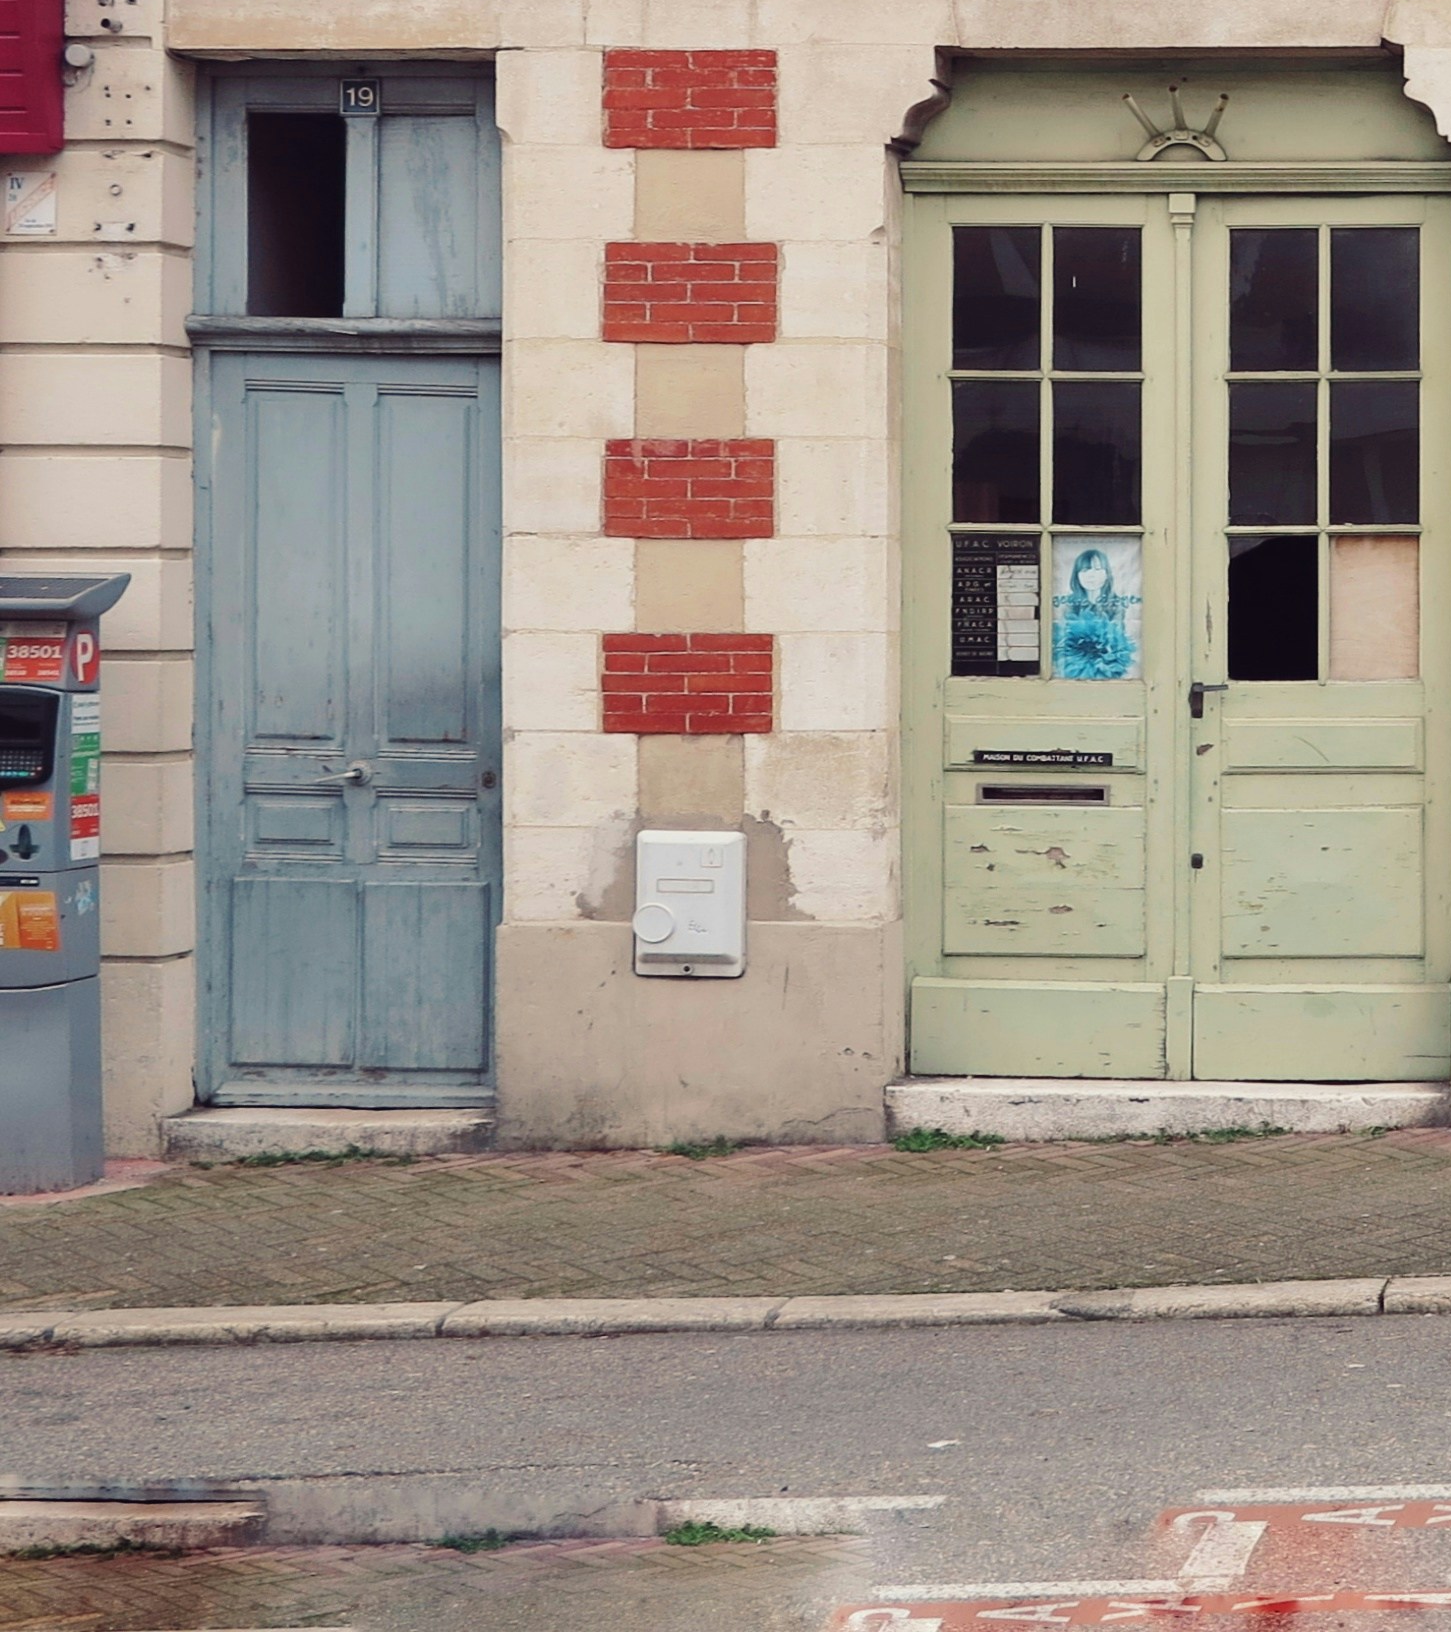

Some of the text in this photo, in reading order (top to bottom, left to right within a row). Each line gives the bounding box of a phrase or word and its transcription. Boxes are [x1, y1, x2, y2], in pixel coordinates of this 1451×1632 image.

[346, 87, 374, 107] 19
[7, 645, 62, 658] 38501
[77, 633, 94, 681] P
[1026, 754, 1073, 762] COMBATTANT
